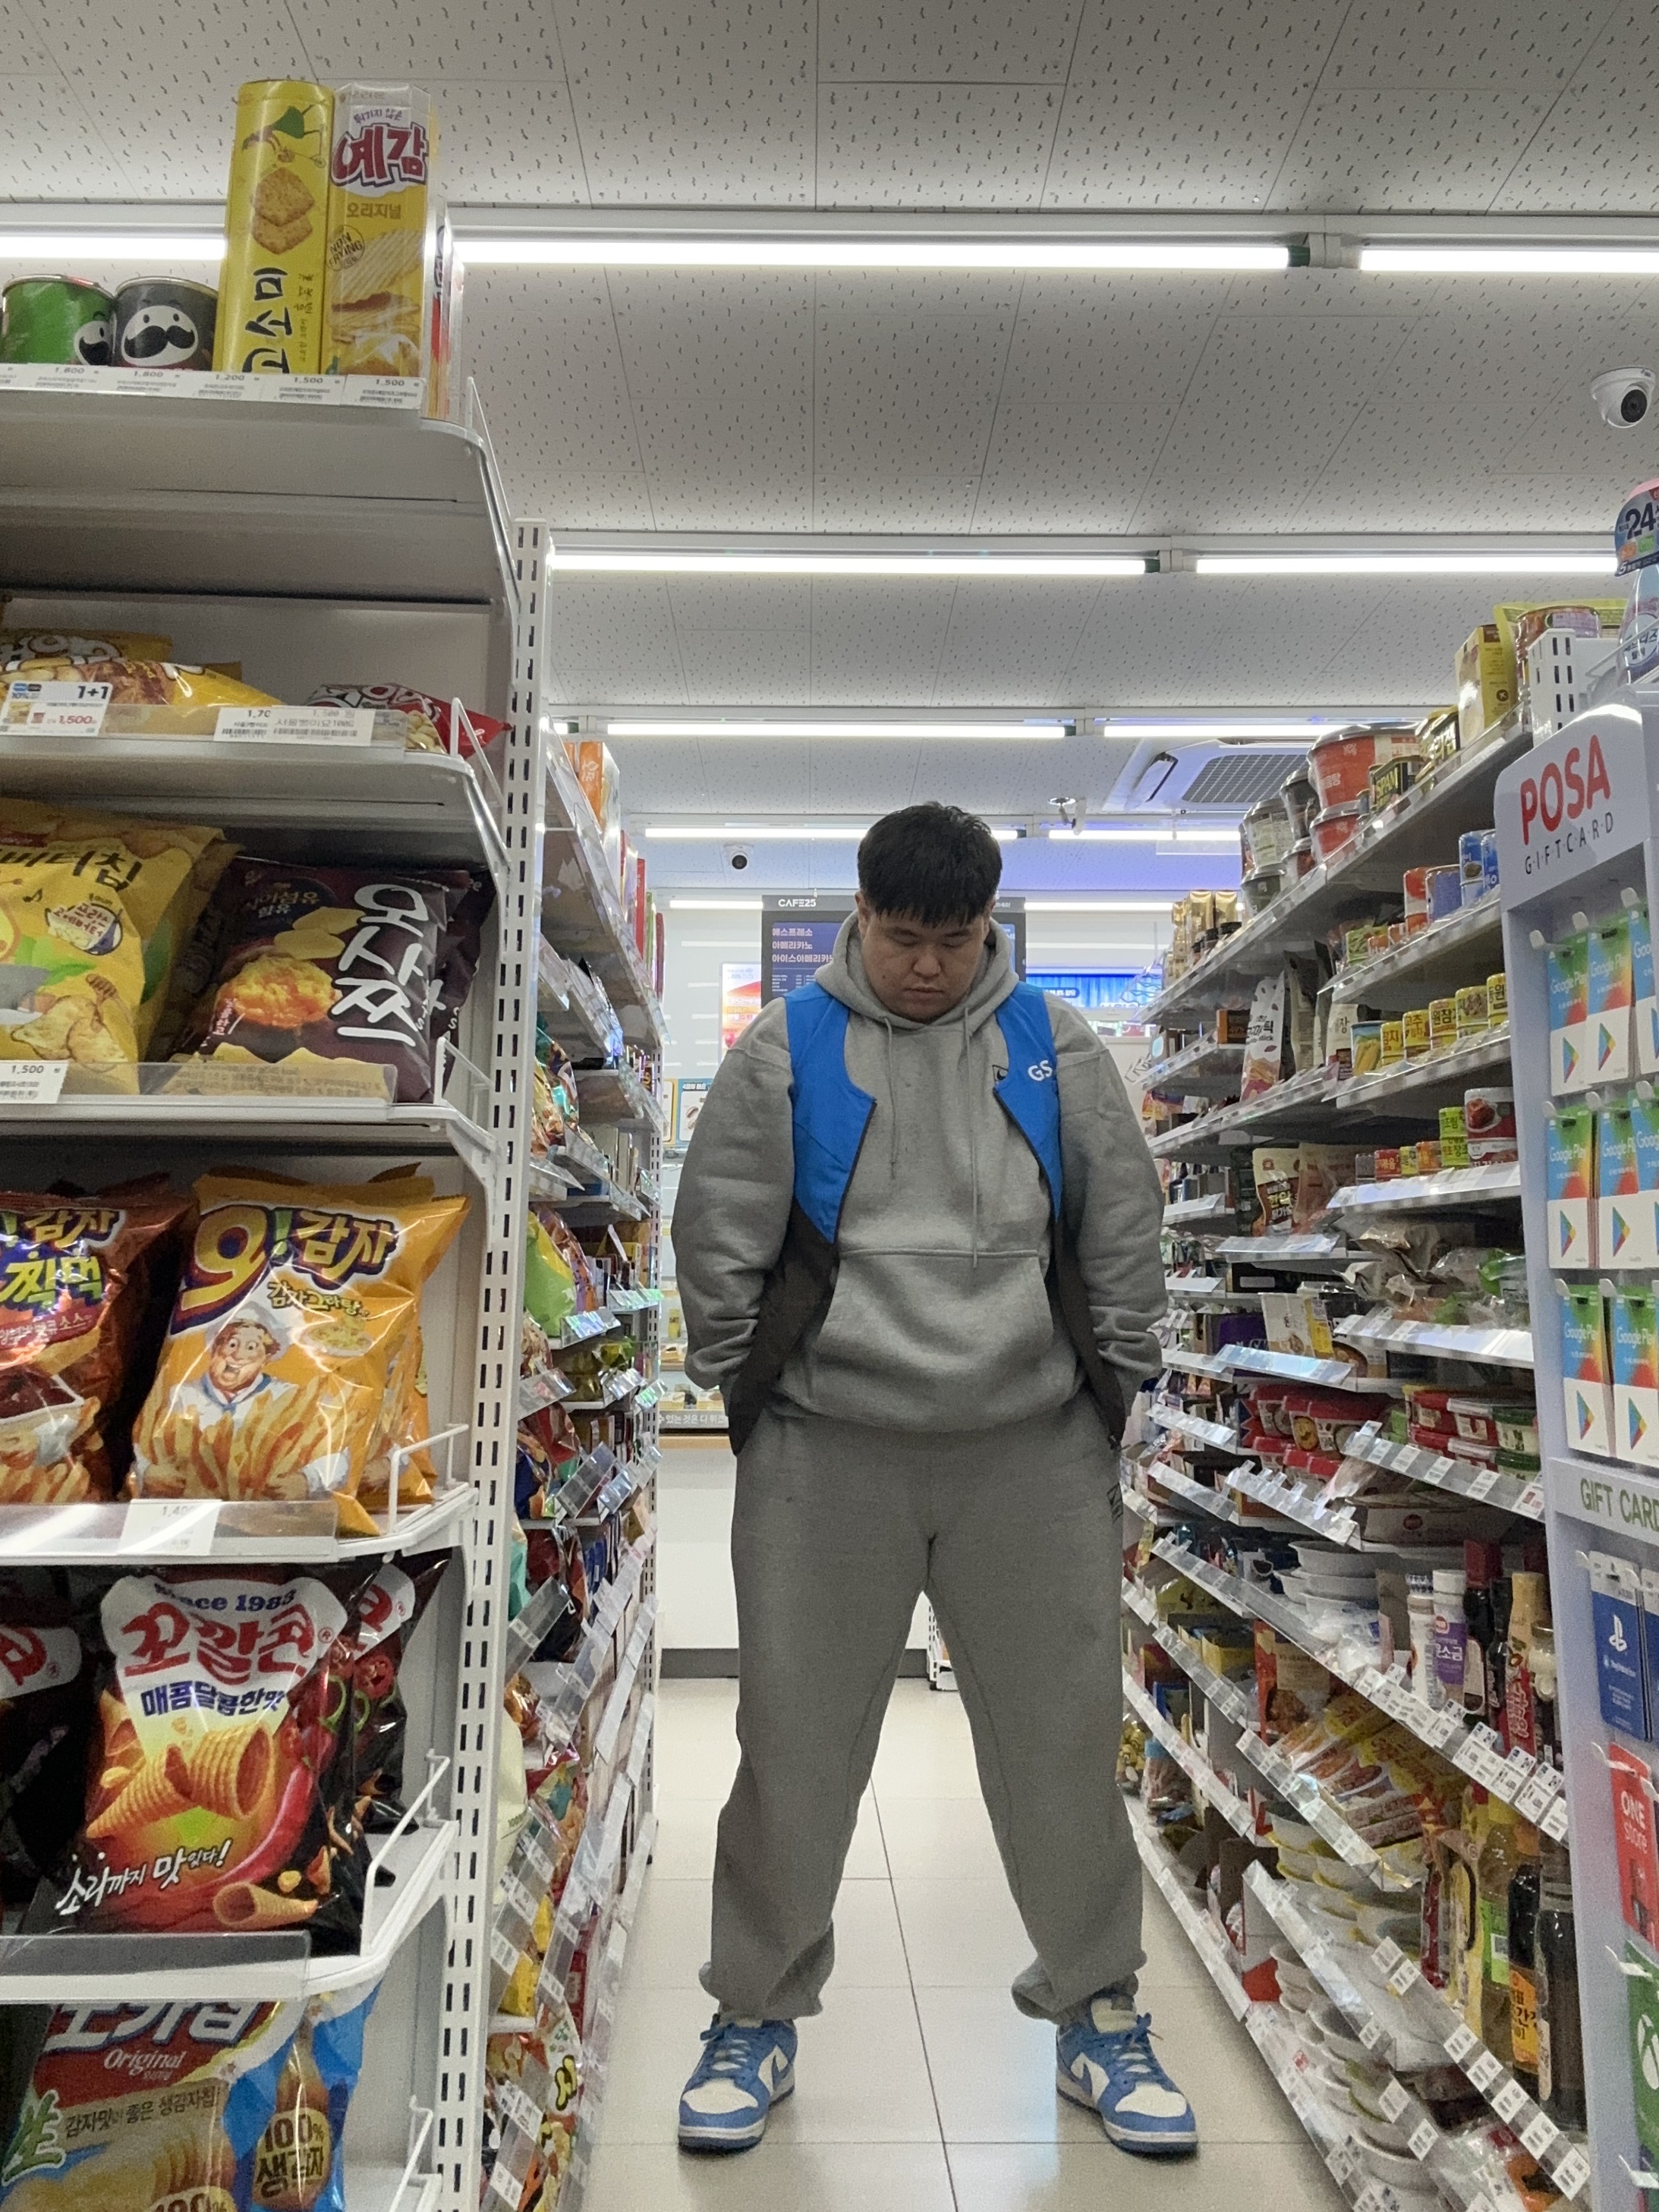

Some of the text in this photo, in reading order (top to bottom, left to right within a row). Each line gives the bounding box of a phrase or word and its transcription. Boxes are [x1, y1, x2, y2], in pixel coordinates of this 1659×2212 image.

[354, 107, 404, 124] 튀기지 않은
[332, 123, 427, 185] 예감
[346, 202, 402, 220] 오리지널
[329, 231, 351, 253] NON
[329, 240, 362, 269] FRYING
[241, 267, 293, 374] 고소미
[78, 684, 109, 700] 1+1
[58, 715, 93, 725] 1,500
[1375, 766, 1399, 800] SPAM
[1520, 734, 1611, 845] POSA
[778, 898, 817, 908] CAFE25
[772, 927, 814, 937] 에스프레소
[772, 940, 814, 950] 아메리카노
[330, 883, 430, 1047] 오사쯔
[1591, 959, 1614, 977] Google
[1550, 974, 1574, 994] Google
[11, 1065, 45, 1074] 1,500
[1027, 1059, 1053, 1081] GS
[1550, 1147, 1573, 1166] Google
[1603, 1140, 1628, 1159] Google
[0, 1249, 103, 1310] 찍먹
[59, 1311, 88, 1332] 소스
[1563, 1321, 1587, 1344] Google
[1617, 1326, 1642, 1350] Google
[1579, 1477, 1659, 1534] GIFT CARD
[235, 1588, 297, 1612] 1983
[121, 1602, 317, 1686] 꼬깔콘
[140, 1679, 287, 1717] 매콤달콤한맛
[1620, 1789, 1646, 1830] ONE
[1623, 1821, 1648, 1855] store
[54, 1838, 234, 1917] 소리까지 맛있다!
[104, 2047, 187, 2078] Original
[125, 2100, 156, 2125] 좋은
[158, 2084, 219, 2118] 생감자칩
[263, 2115, 325, 2154] 100%
[257, 2147, 325, 2201] 생감자
